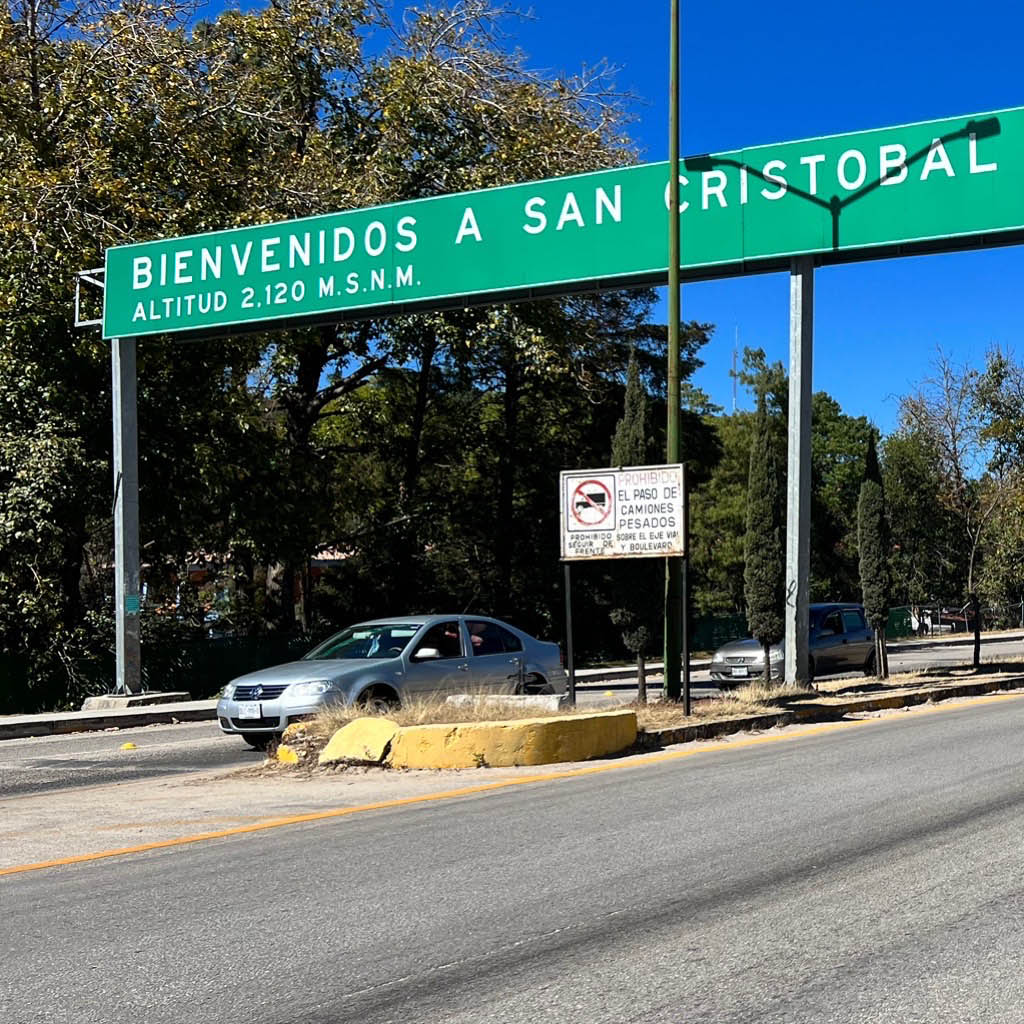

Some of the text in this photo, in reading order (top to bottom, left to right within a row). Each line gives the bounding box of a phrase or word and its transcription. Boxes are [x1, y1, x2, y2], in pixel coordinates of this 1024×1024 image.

[132, 216, 418, 291] BIENVENIDOS
[455, 207, 483, 244] A
[522, 184, 622, 234] SAN
[664, 132, 998, 214] CRISTOBAL
[132, 291, 228, 322] ALTITUD
[318, 264, 422, 299] M.S.N.M.
[618, 486, 677, 501] EL PASO DE
[621, 503, 674, 515] CAMIONES
[620, 516, 676, 529] PESADOS
[570, 532, 613, 541] PROHIBIDO
[616, 532, 637, 541] SOBRE
[639, 532, 646, 540] EL
[649, 531, 663, 540] EJE
